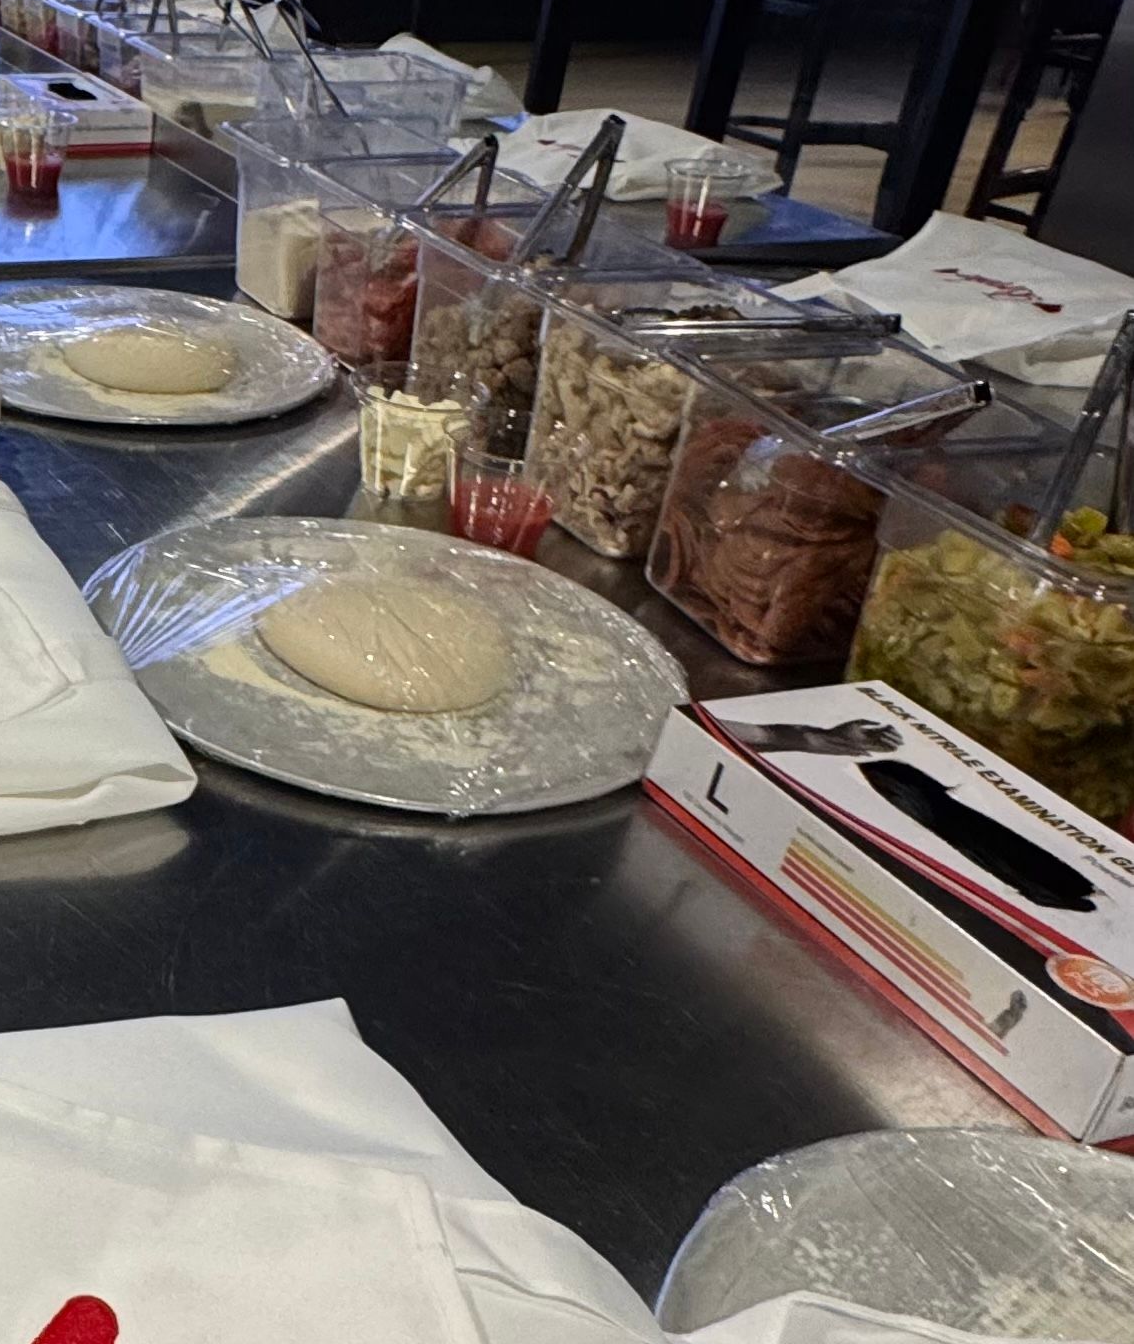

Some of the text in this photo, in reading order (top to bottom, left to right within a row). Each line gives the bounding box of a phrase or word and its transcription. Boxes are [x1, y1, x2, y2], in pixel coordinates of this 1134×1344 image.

[707, 762, 729, 815] L
[856, 687, 915, 720] BLACK
[910, 721, 985, 768] NITRILE
[976, 769, 1114, 855] EXAMINATION
